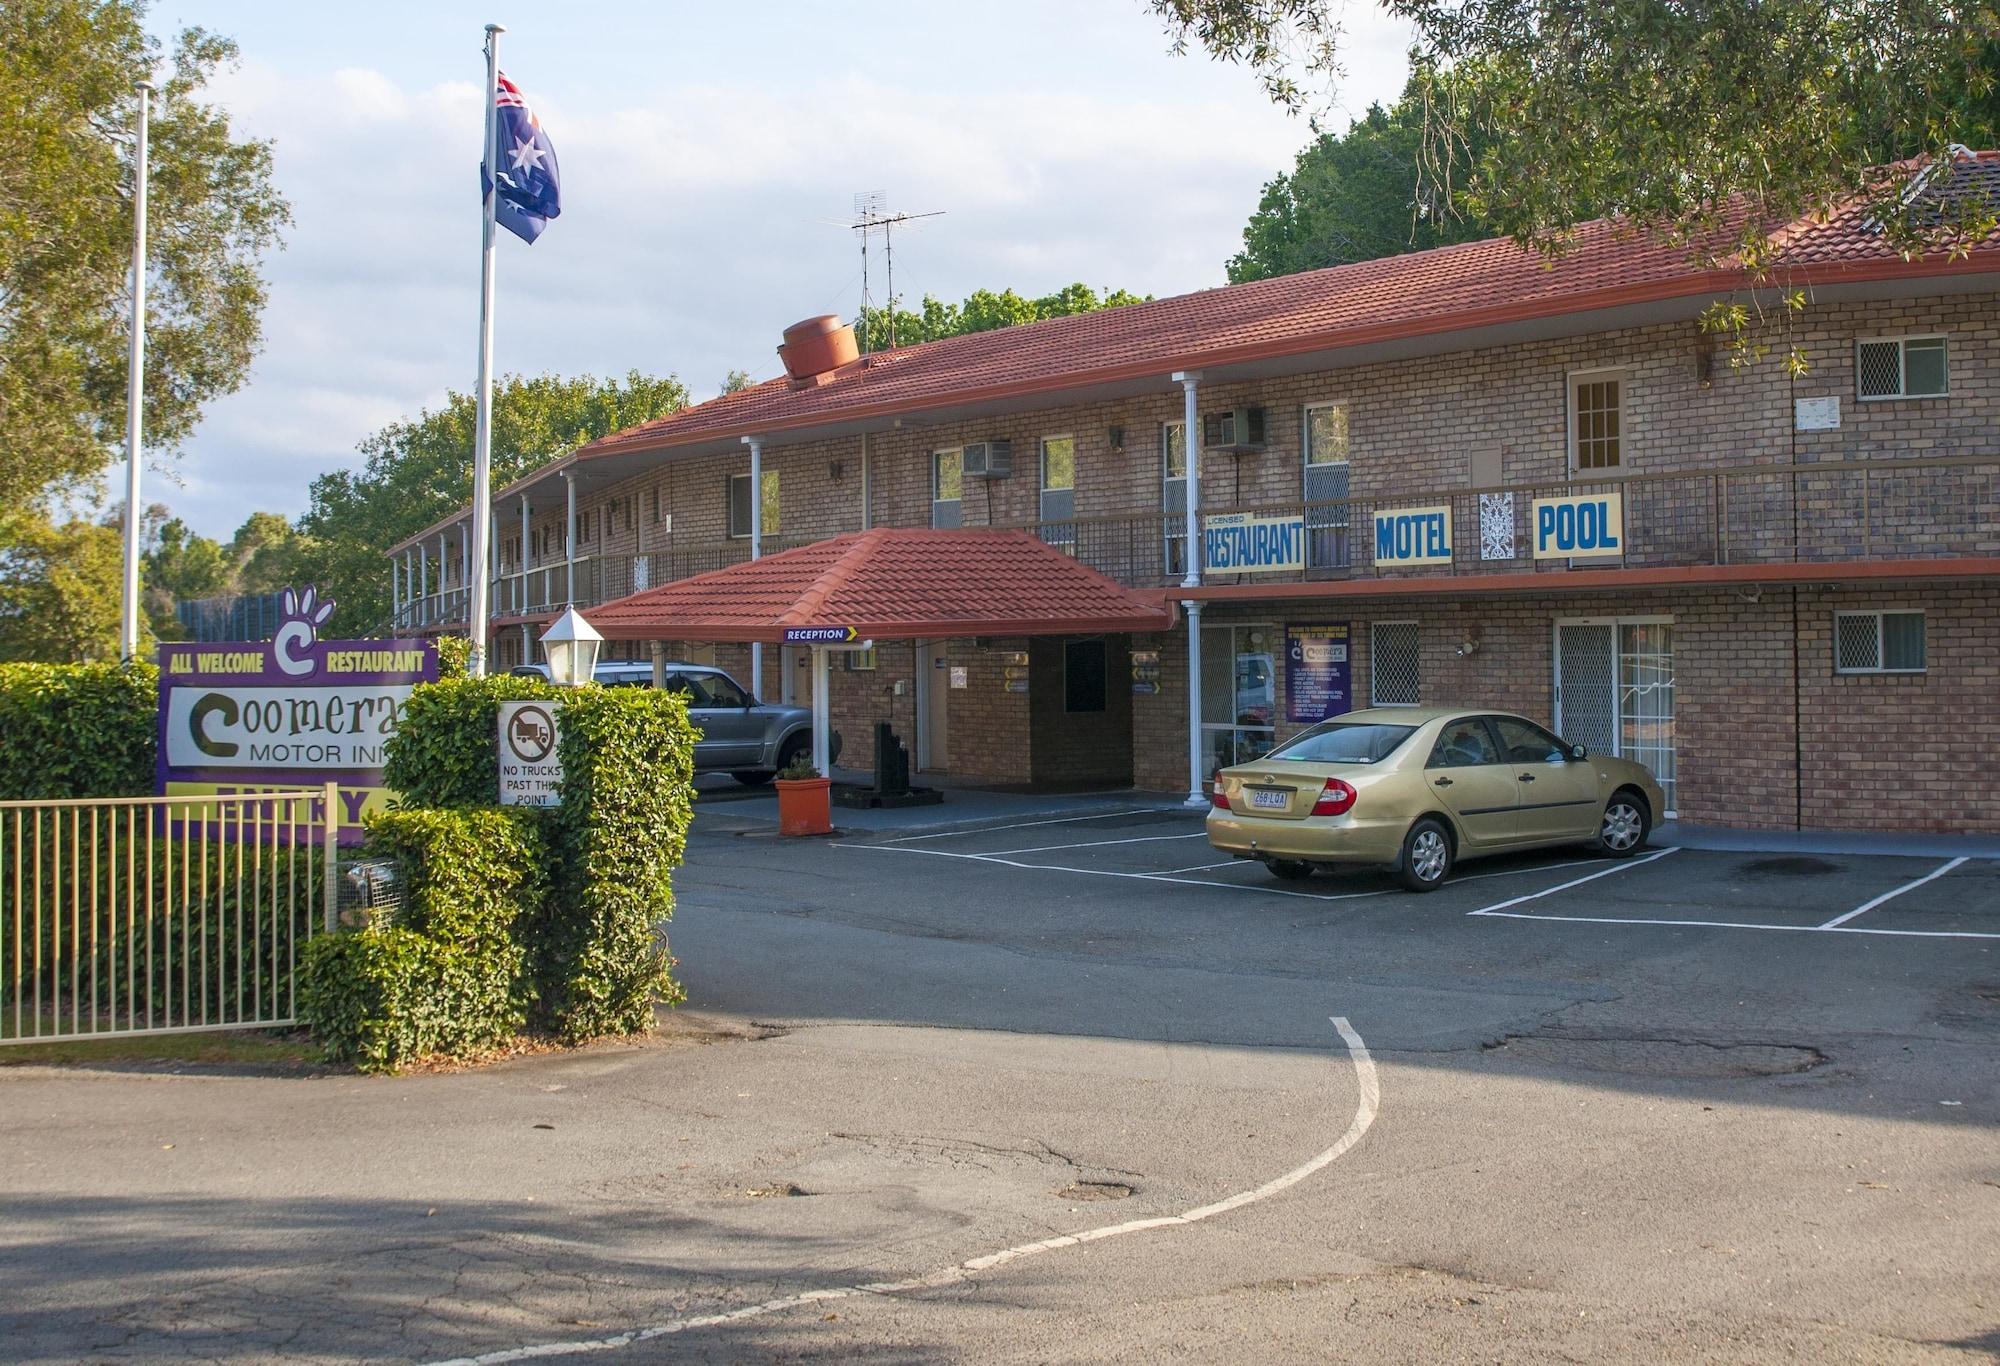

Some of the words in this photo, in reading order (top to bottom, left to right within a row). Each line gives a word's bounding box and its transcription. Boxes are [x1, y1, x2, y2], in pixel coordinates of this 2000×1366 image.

[1207, 516, 1245, 525] LICENSED
[1538, 501, 1617, 551] POOL
[1206, 522, 1303, 568] RESTAURANT
[1376, 512, 1450, 560] MOTEL
[787, 630, 844, 640] RECEPTION
[169, 653, 193, 673] ALL
[197, 652, 264, 673] WELCOME
[326, 650, 425, 673] RESTAURANT
[189, 692, 398, 758] Coomera
[250, 744, 341, 763] MOTOR
[503, 766, 518, 776] NO
[522, 766, 561, 776] TRUCKS
[507, 780, 531, 790] PAST
[517, 795, 547, 805] POINT
